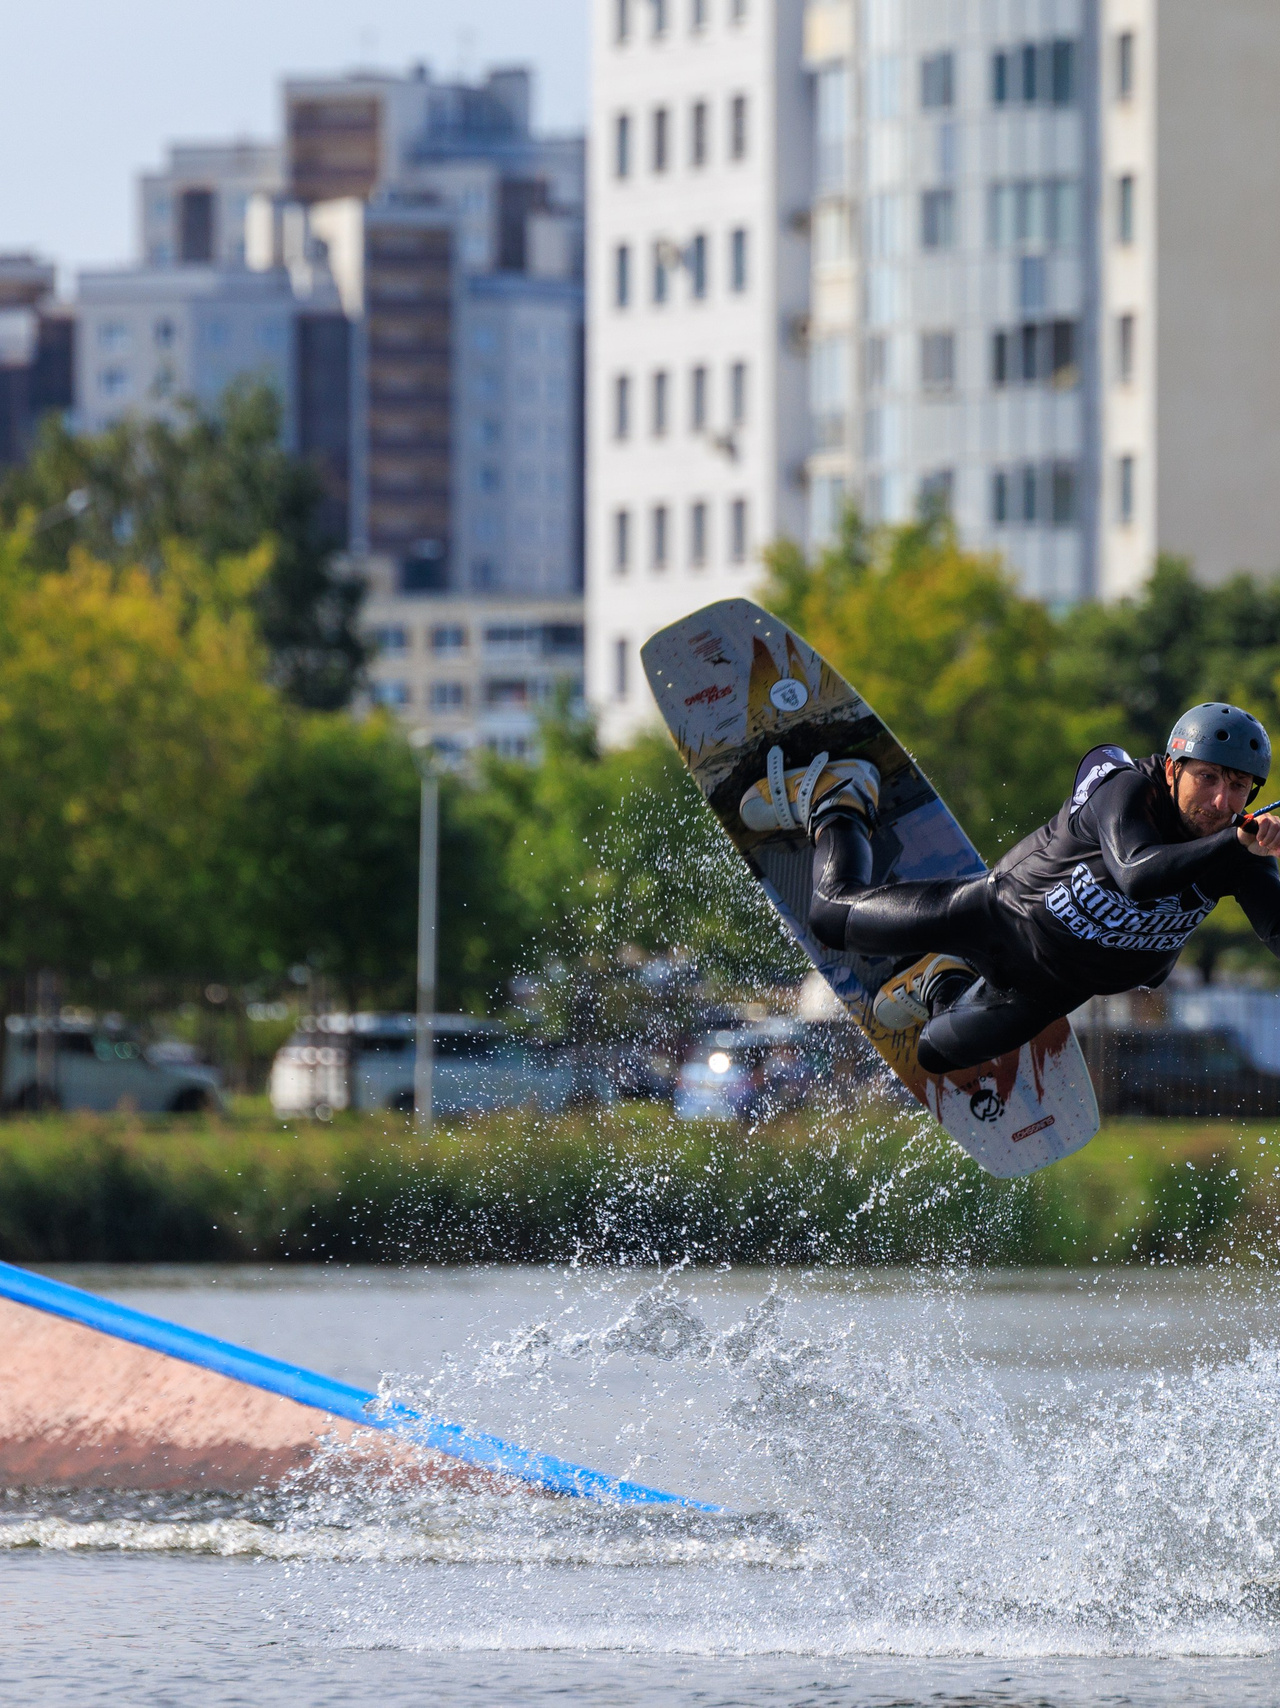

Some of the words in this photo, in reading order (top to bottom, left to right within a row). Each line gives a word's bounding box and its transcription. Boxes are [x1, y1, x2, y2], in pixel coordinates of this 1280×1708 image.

[1047, 886, 1098, 940] OPEN
[1101, 933, 1186, 950] CONTES
[1013, 1116, 1054, 1140] SLINGSHOT
